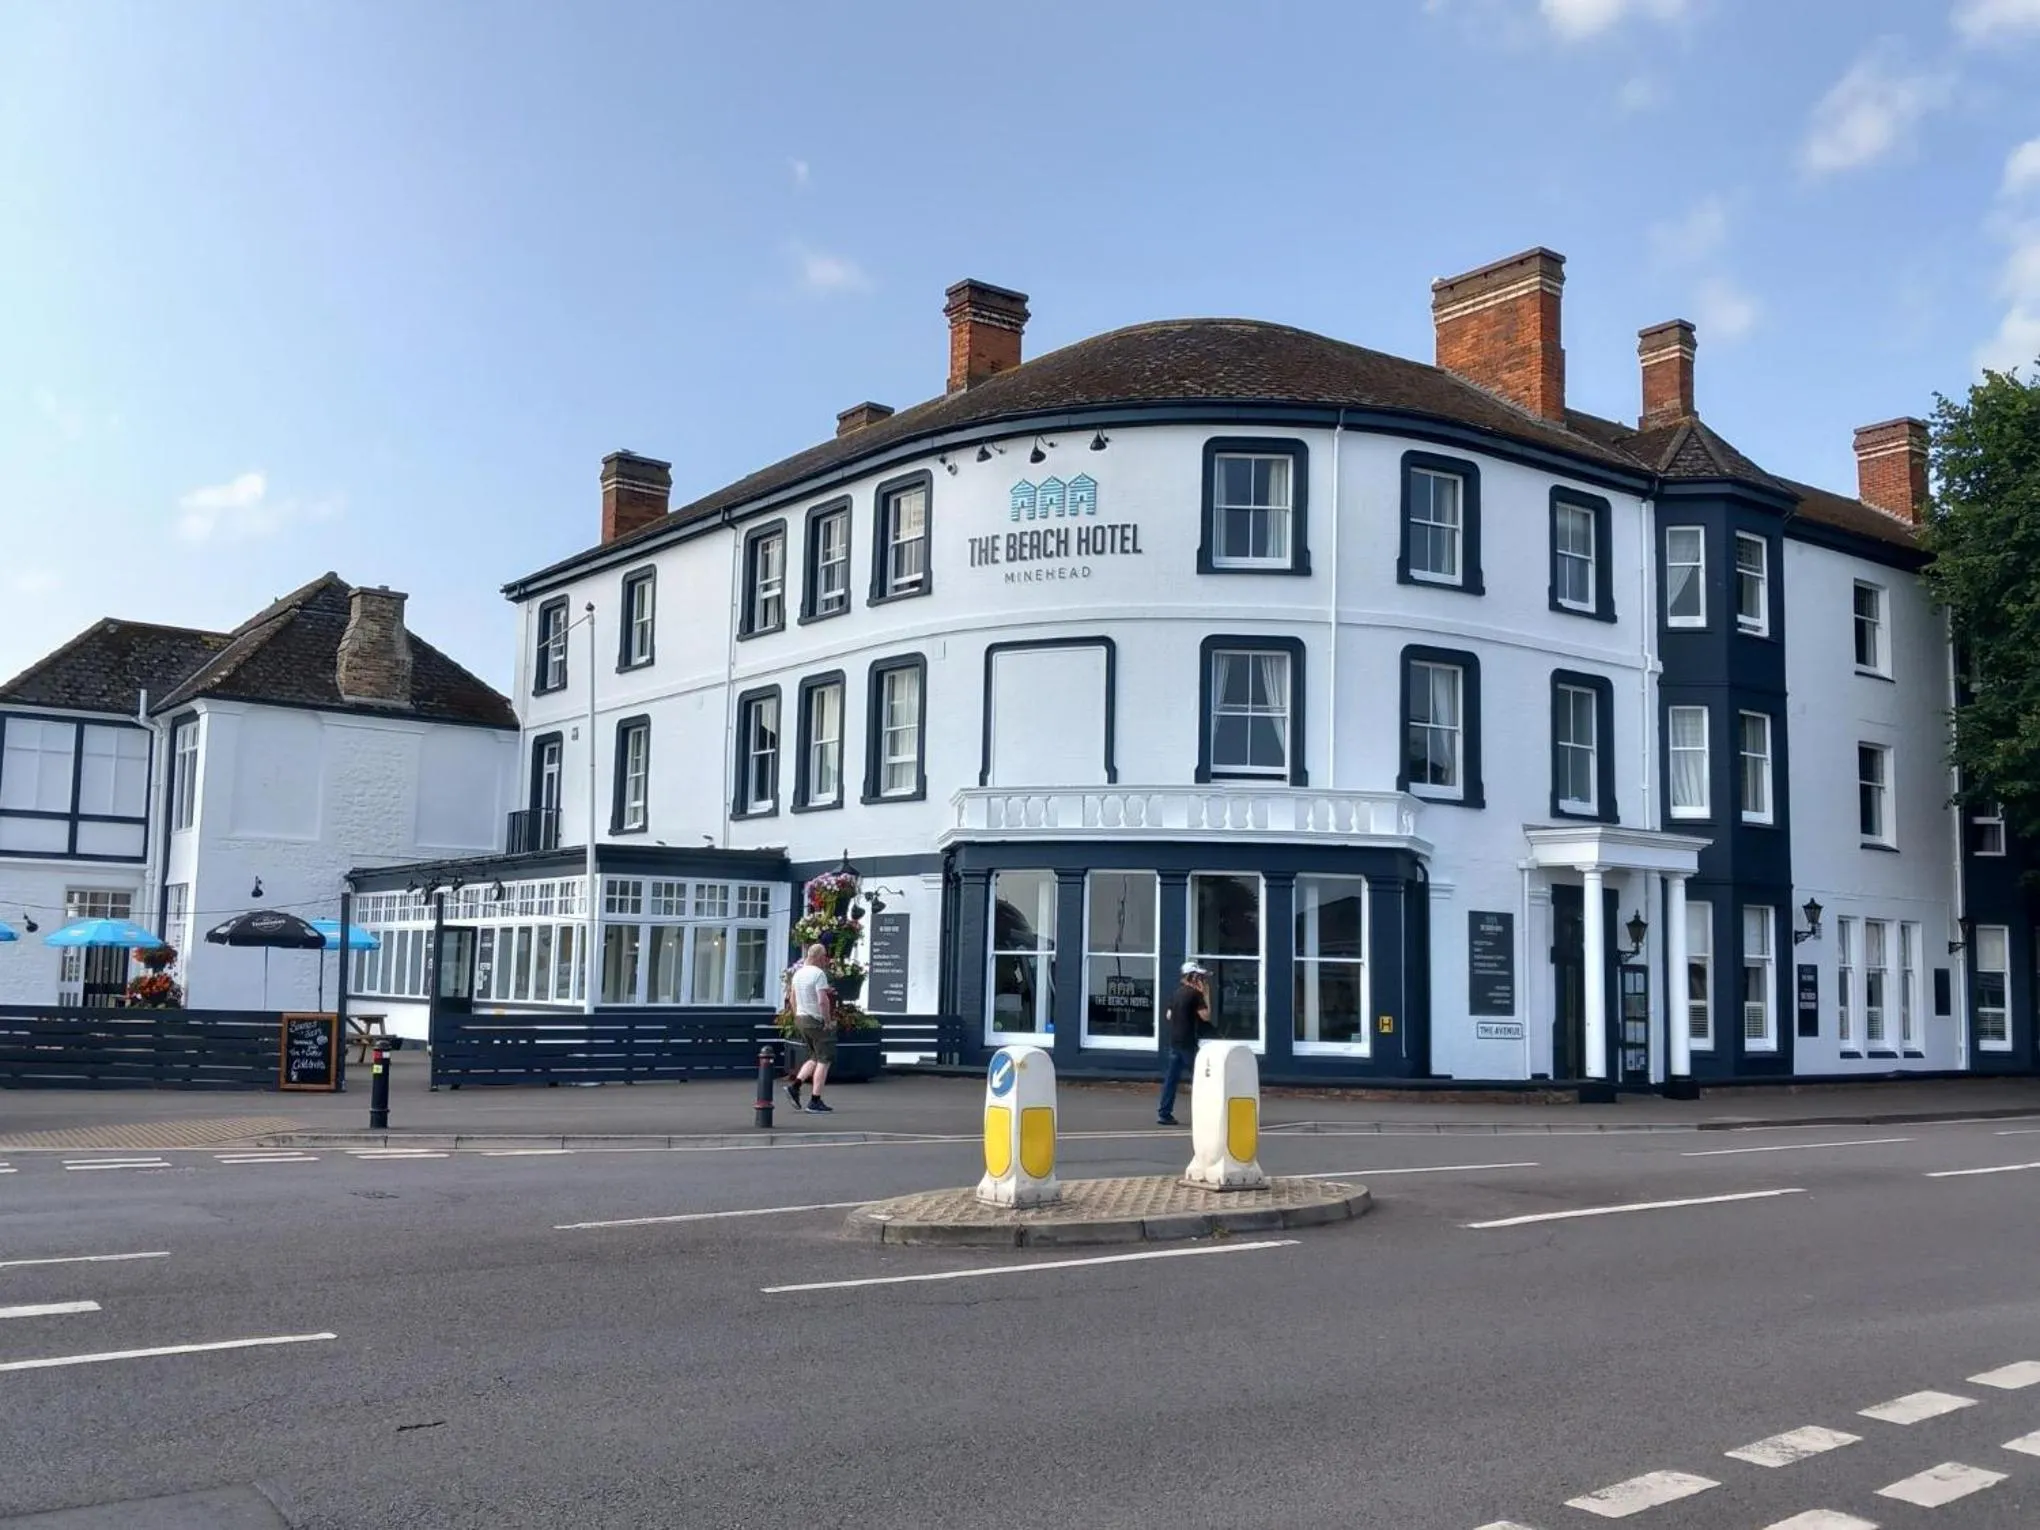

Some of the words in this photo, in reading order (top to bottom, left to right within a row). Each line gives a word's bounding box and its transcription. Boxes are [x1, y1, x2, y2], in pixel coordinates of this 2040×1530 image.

[968, 535, 1000, 567] THE
[1006, 527, 1070, 563] BEACH
[1077, 523, 1143, 556] HOTEL
[1004, 566, 1092, 584] MINEHEAD
[1480, 1026, 1493, 1035] THE
[1494, 1026, 1520, 1036] AVENUE
